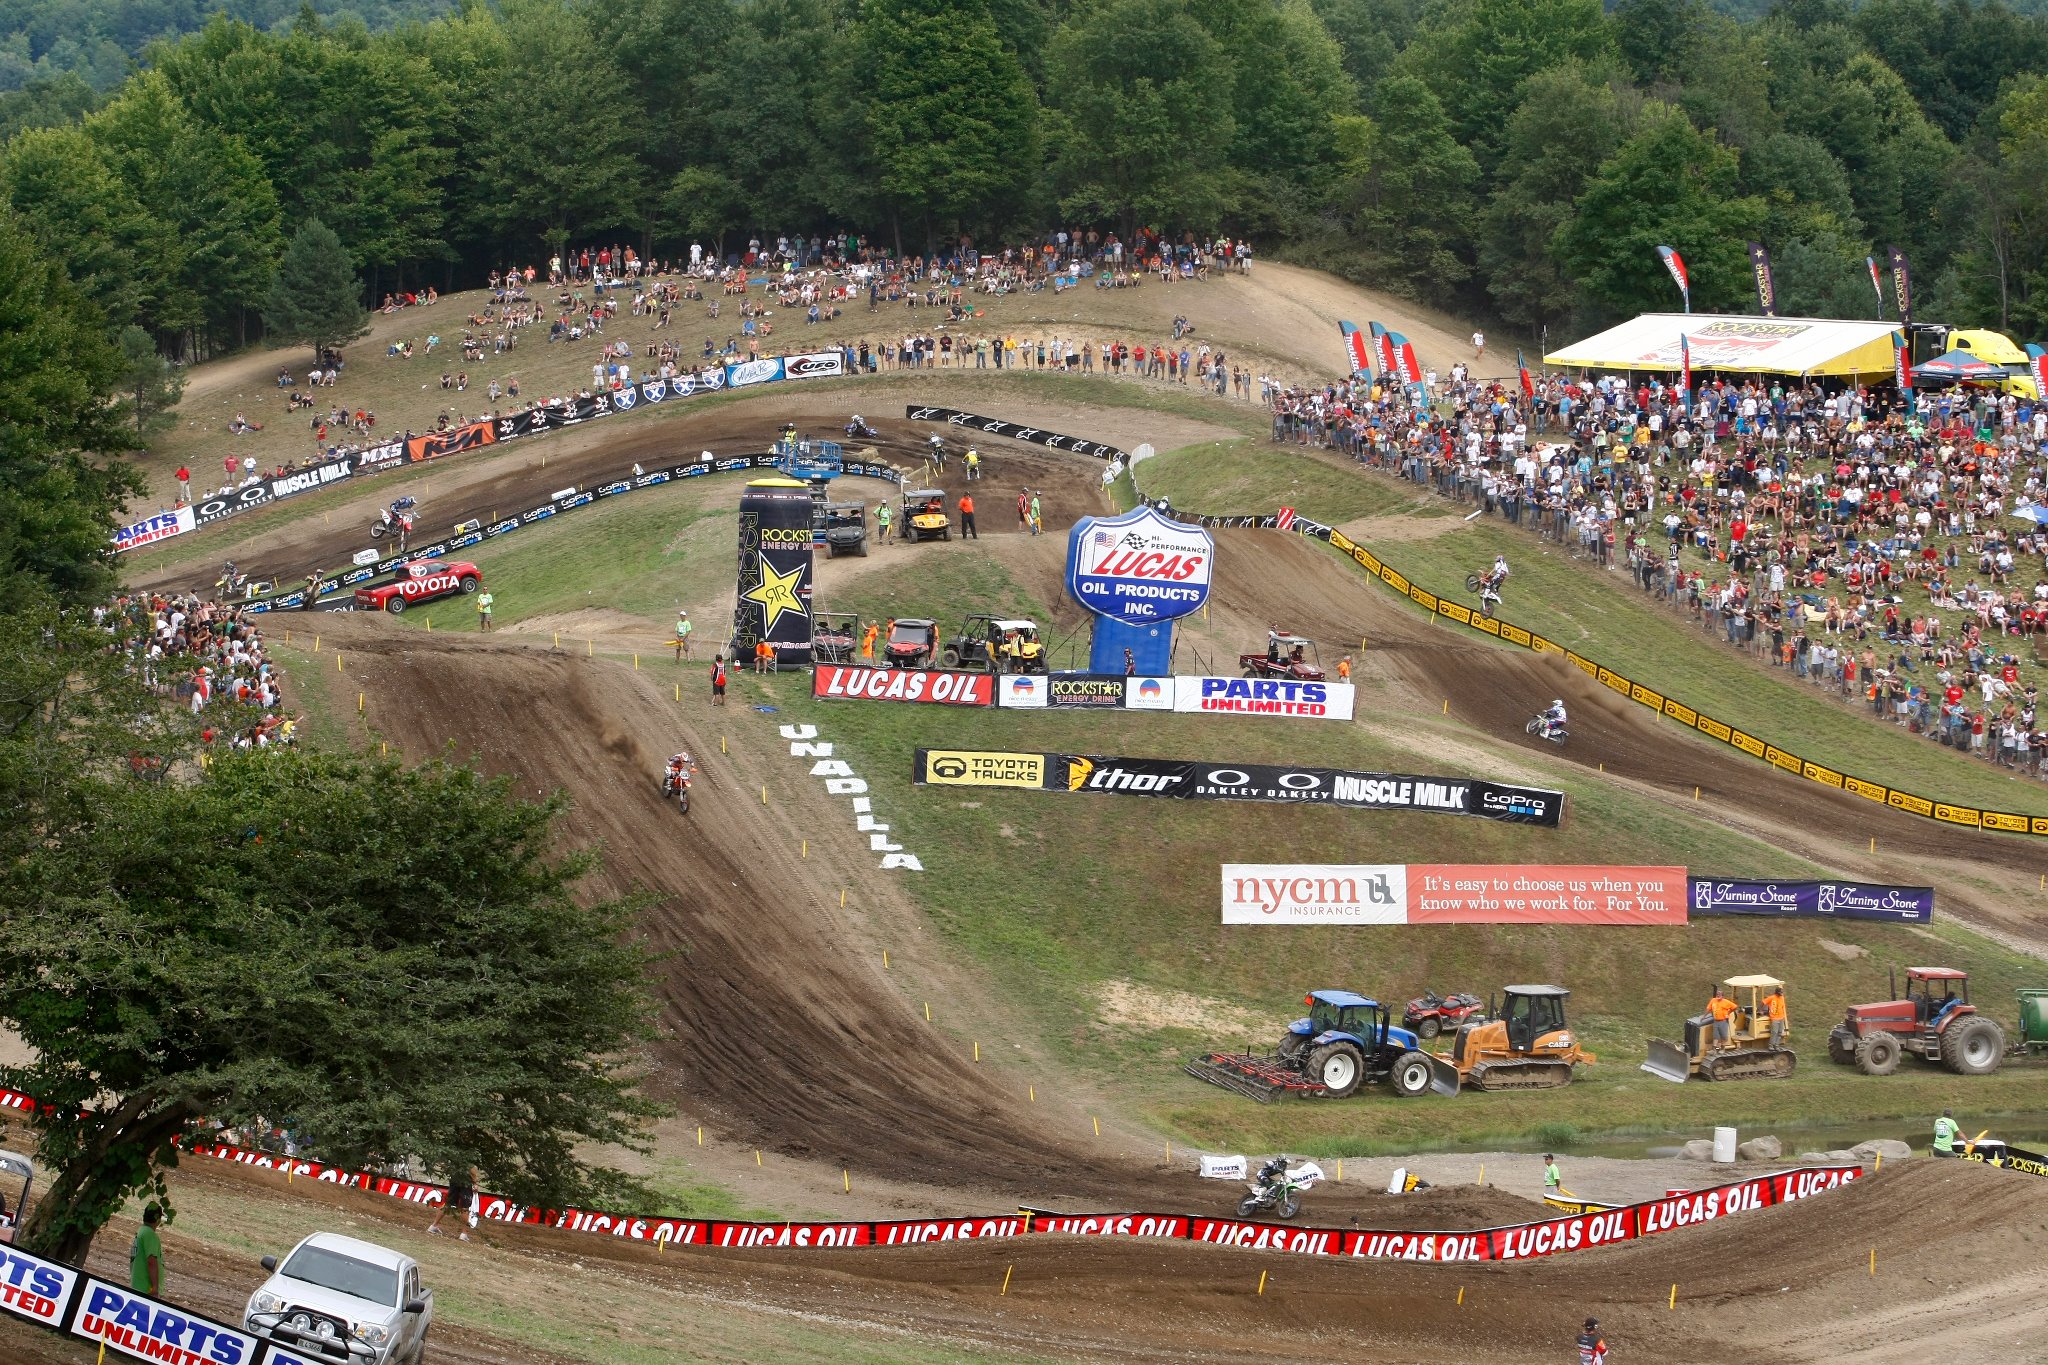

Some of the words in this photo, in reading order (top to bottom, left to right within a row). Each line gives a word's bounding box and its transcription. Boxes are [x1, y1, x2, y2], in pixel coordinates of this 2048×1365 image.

[1757, 264, 1769, 307] ROCKSTAR
[1894, 267, 1906, 311] ROCKSTAR
[1344, 333, 1359, 373] makita
[1373, 335, 1387, 374] makita
[1395, 345, 1412, 386] makita
[1895, 347, 1906, 390] makita
[2031, 357, 2046, 398] makita
[377, 458, 403, 470] TOYS
[676, 463, 710, 478] GoPro
[716, 456, 751, 471] GoPro
[271, 470, 319, 498] MUSCLE
[319, 459, 352, 481] MILK
[636, 470, 670, 486] GoPro
[598, 480, 631, 495] GoPro
[235, 493, 275, 511] OAKLEY
[560, 491, 593, 508] GoPro
[196, 508, 234, 526] OAKLEY
[523, 504, 555, 521] GoPro
[116, 512, 178, 542] ARTS
[487, 518, 518, 534] GoPro
[450, 531, 482, 547] GoPro
[762, 541, 799, 550] ENERGY
[414, 544, 445, 559] GoPro
[1150, 545, 1207, 554] PERFORMANCE
[379, 555, 409, 571] GoPro
[1091, 550, 1203, 581] LUCAS
[343, 567, 373, 582] GoPro
[394, 575, 460, 596] TOYOTA
[1081, 582, 1110, 595] OIL
[1115, 583, 1200, 602] PRODUCTS
[242, 600, 271, 611] GoPro
[275, 591, 304, 605] GoPro
[1124, 602, 1157, 616] INC.
[827, 669, 927, 701] LUCAS
[931, 674, 980, 702] OIL
[1051, 680, 1122, 696] ROCKSTAR
[1202, 678, 1326, 703] PARTS
[1057, 695, 1088, 703] ENERGY
[1092, 695, 1116, 703] DRINK
[1201, 699, 1326, 716] UNLIMITED
[972, 758, 1038, 770] TOYOTA
[971, 770, 1037, 782] TRUCKS
[1089, 768, 1182, 792] thor
[1818, 775, 1840, 787] TRUCKS
[1819, 770, 1841, 781] TOYOTA
[1196, 785, 1260, 797] OAKLEY
[1268, 789, 1330, 800] OAKLEY
[1333, 775, 1411, 805] MUSCLE
[1413, 782, 1464, 809] MILK
[1859, 783, 1885, 795] TOYOTA
[1859, 788, 1883, 800] TRUCKS
[1483, 792, 1545, 809] GoPro
[1904, 802, 1929, 814] TRUCKS
[1905, 796, 1931, 808] TOYOTA
[1951, 808, 1978, 818] TOYOTA
[1951, 814, 1977, 823] TRUCKS
[1999, 816, 2025, 825] TOYOTA
[1998, 822, 2025, 831] TRUCKS
[1454, 880, 1488, 896] easy
[1494, 877, 1508, 891] to
[1514, 876, 1564, 891] choose
[1569, 881, 1586, 891] us
[1591, 877, 1632, 892] when
[1636, 881, 1664, 896] you
[1713, 883, 1757, 904] Turning
[1760, 885, 1797, 903] Stone
[1233, 877, 1360, 914] nycm
[1419, 895, 1461, 911] know
[1467, 896, 1499, 910] who
[1503, 899, 1525, 910] we
[1530, 895, 1569, 911] work
[1573, 896, 1597, 911] for.
[1606, 896, 1632, 911] For
[1636, 897, 1668, 912] You.
[1835, 887, 1878, 909] Turning
[1881, 890, 1917, 909] Stone
[1290, 906, 1360, 917] INSURANCE
[1783, 1169, 1854, 1202] LUCAS
[1645, 1196, 1719, 1232] LUCAS
[1725, 1183, 1763, 1214] OIL
[1202, 1222, 1287, 1250] LUCAS
[1290, 1233, 1329, 1255] OIL
[1503, 1219, 1584, 1258] LUCAS
[1588, 1212, 1626, 1242] OIL
[1353, 1235, 1435, 1260] LUCAS
[1440, 1237, 1481, 1261] OIL
[88, 1286, 245, 1365] PARTS
